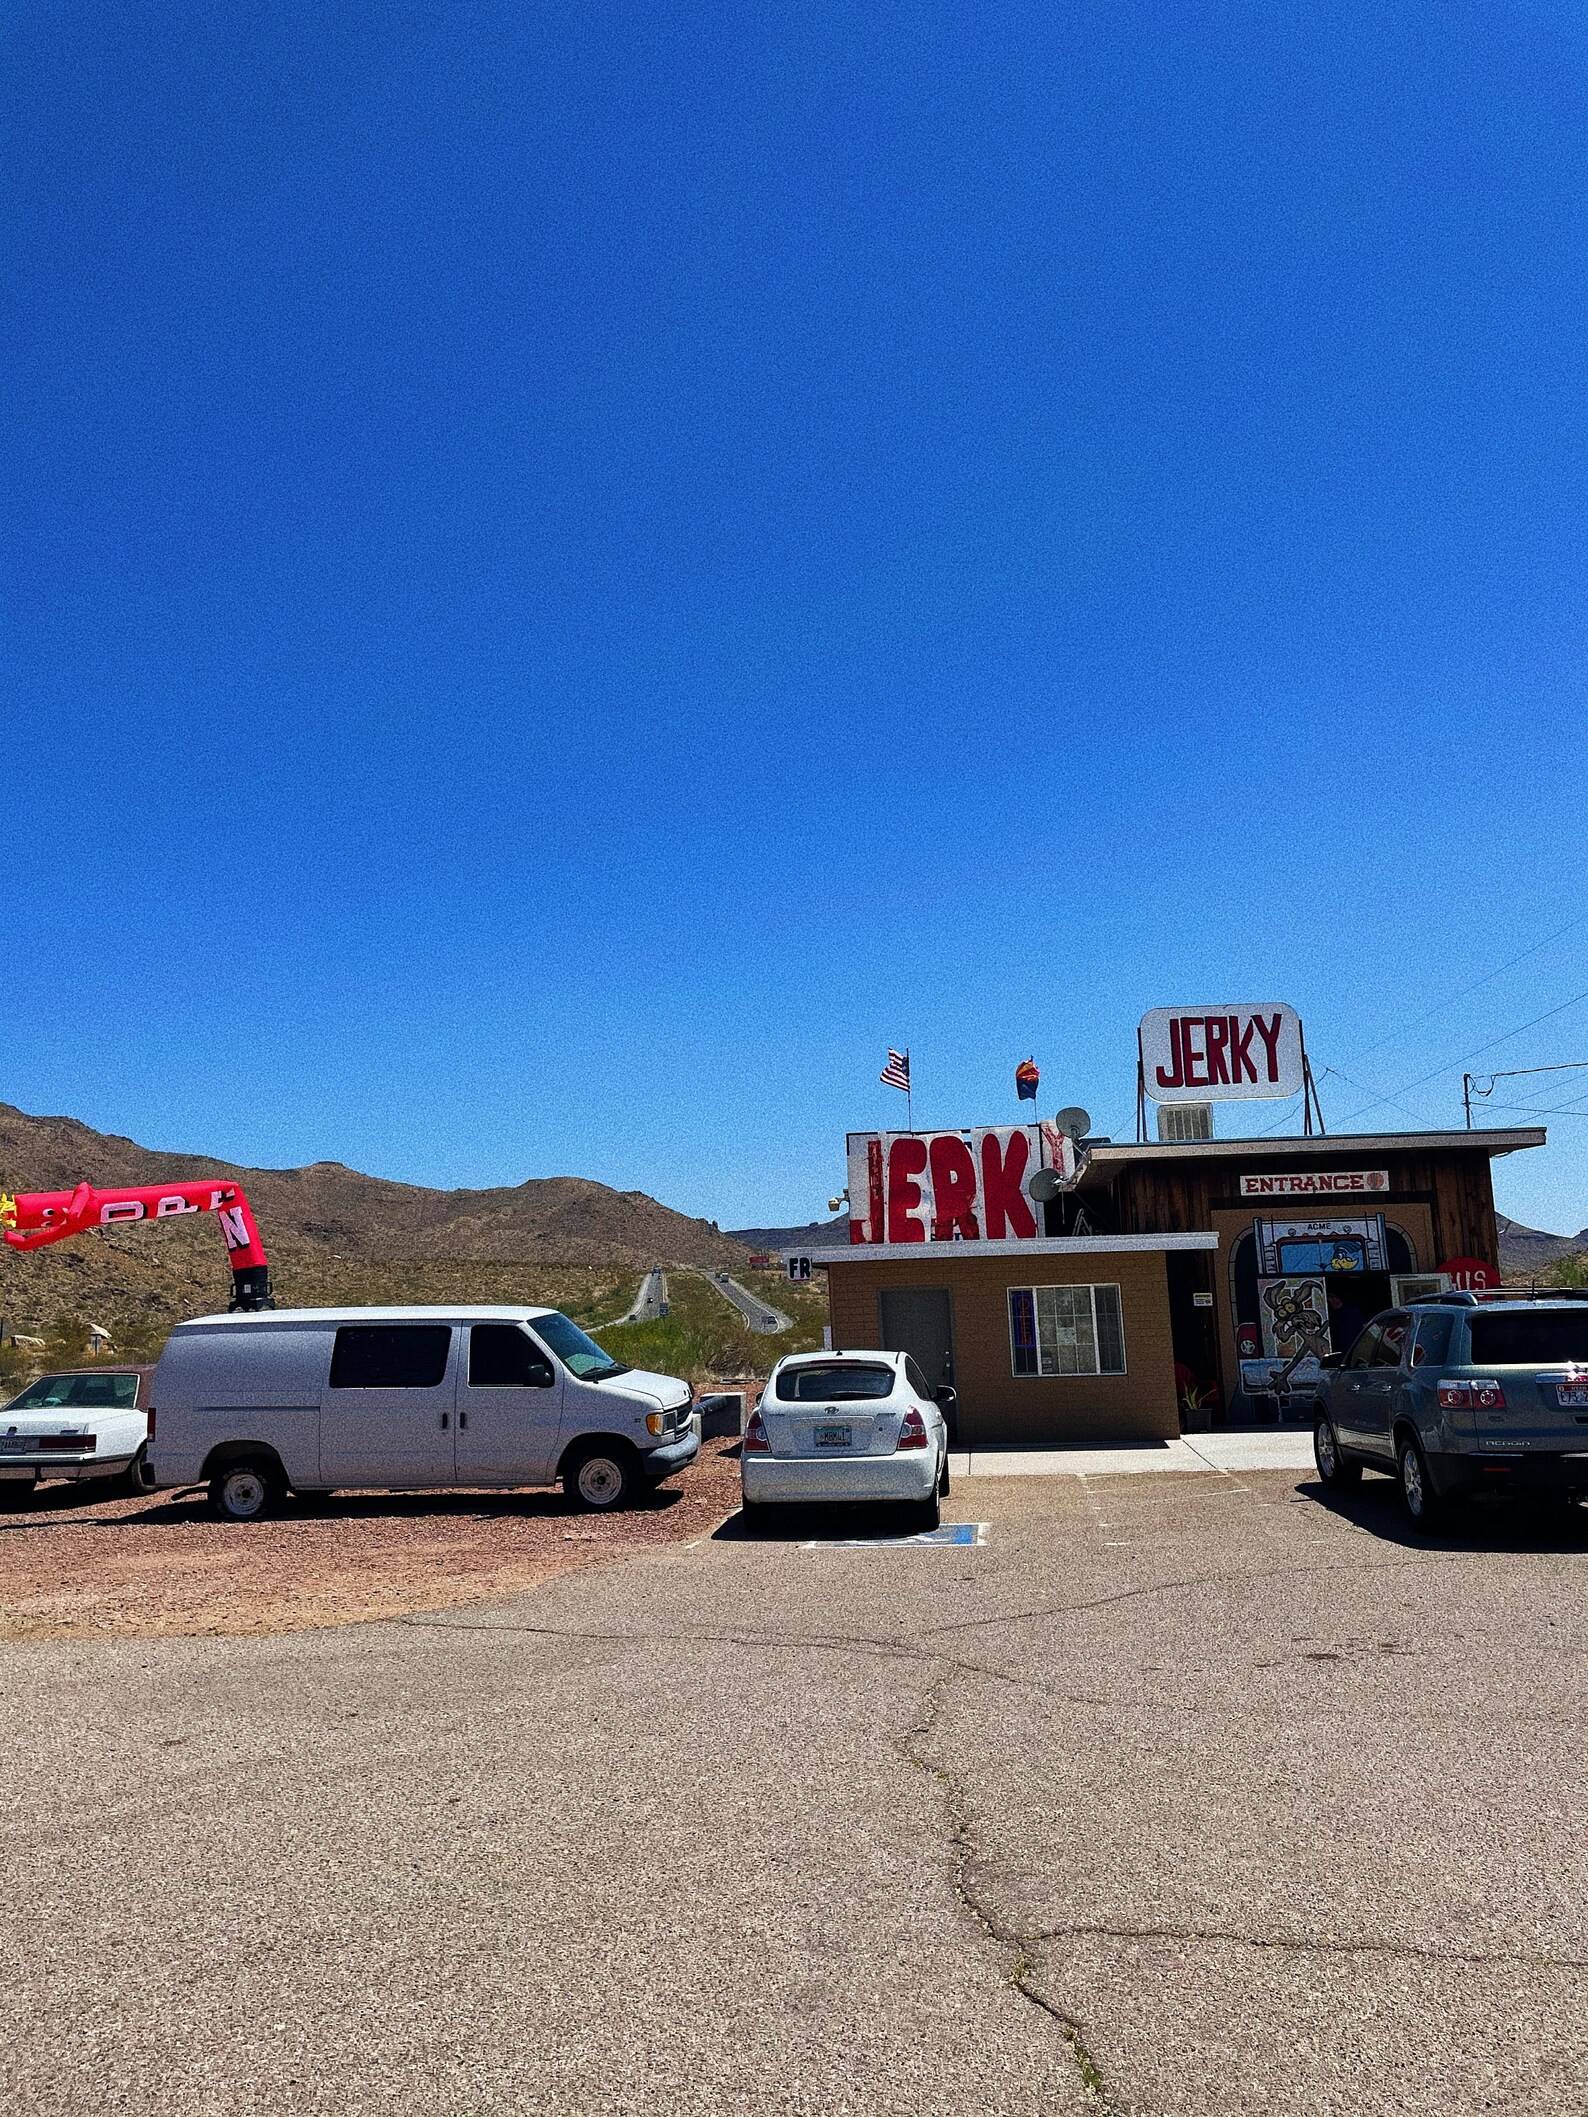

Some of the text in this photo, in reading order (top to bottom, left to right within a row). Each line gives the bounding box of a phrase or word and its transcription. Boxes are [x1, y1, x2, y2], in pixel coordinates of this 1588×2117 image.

[1155, 1013, 1283, 1089] JERKY
[849, 1124, 1067, 1244] JERKY
[1245, 1174, 1365, 1194] ENTRANCE
[1307, 1222, 1332, 1231] ACME
